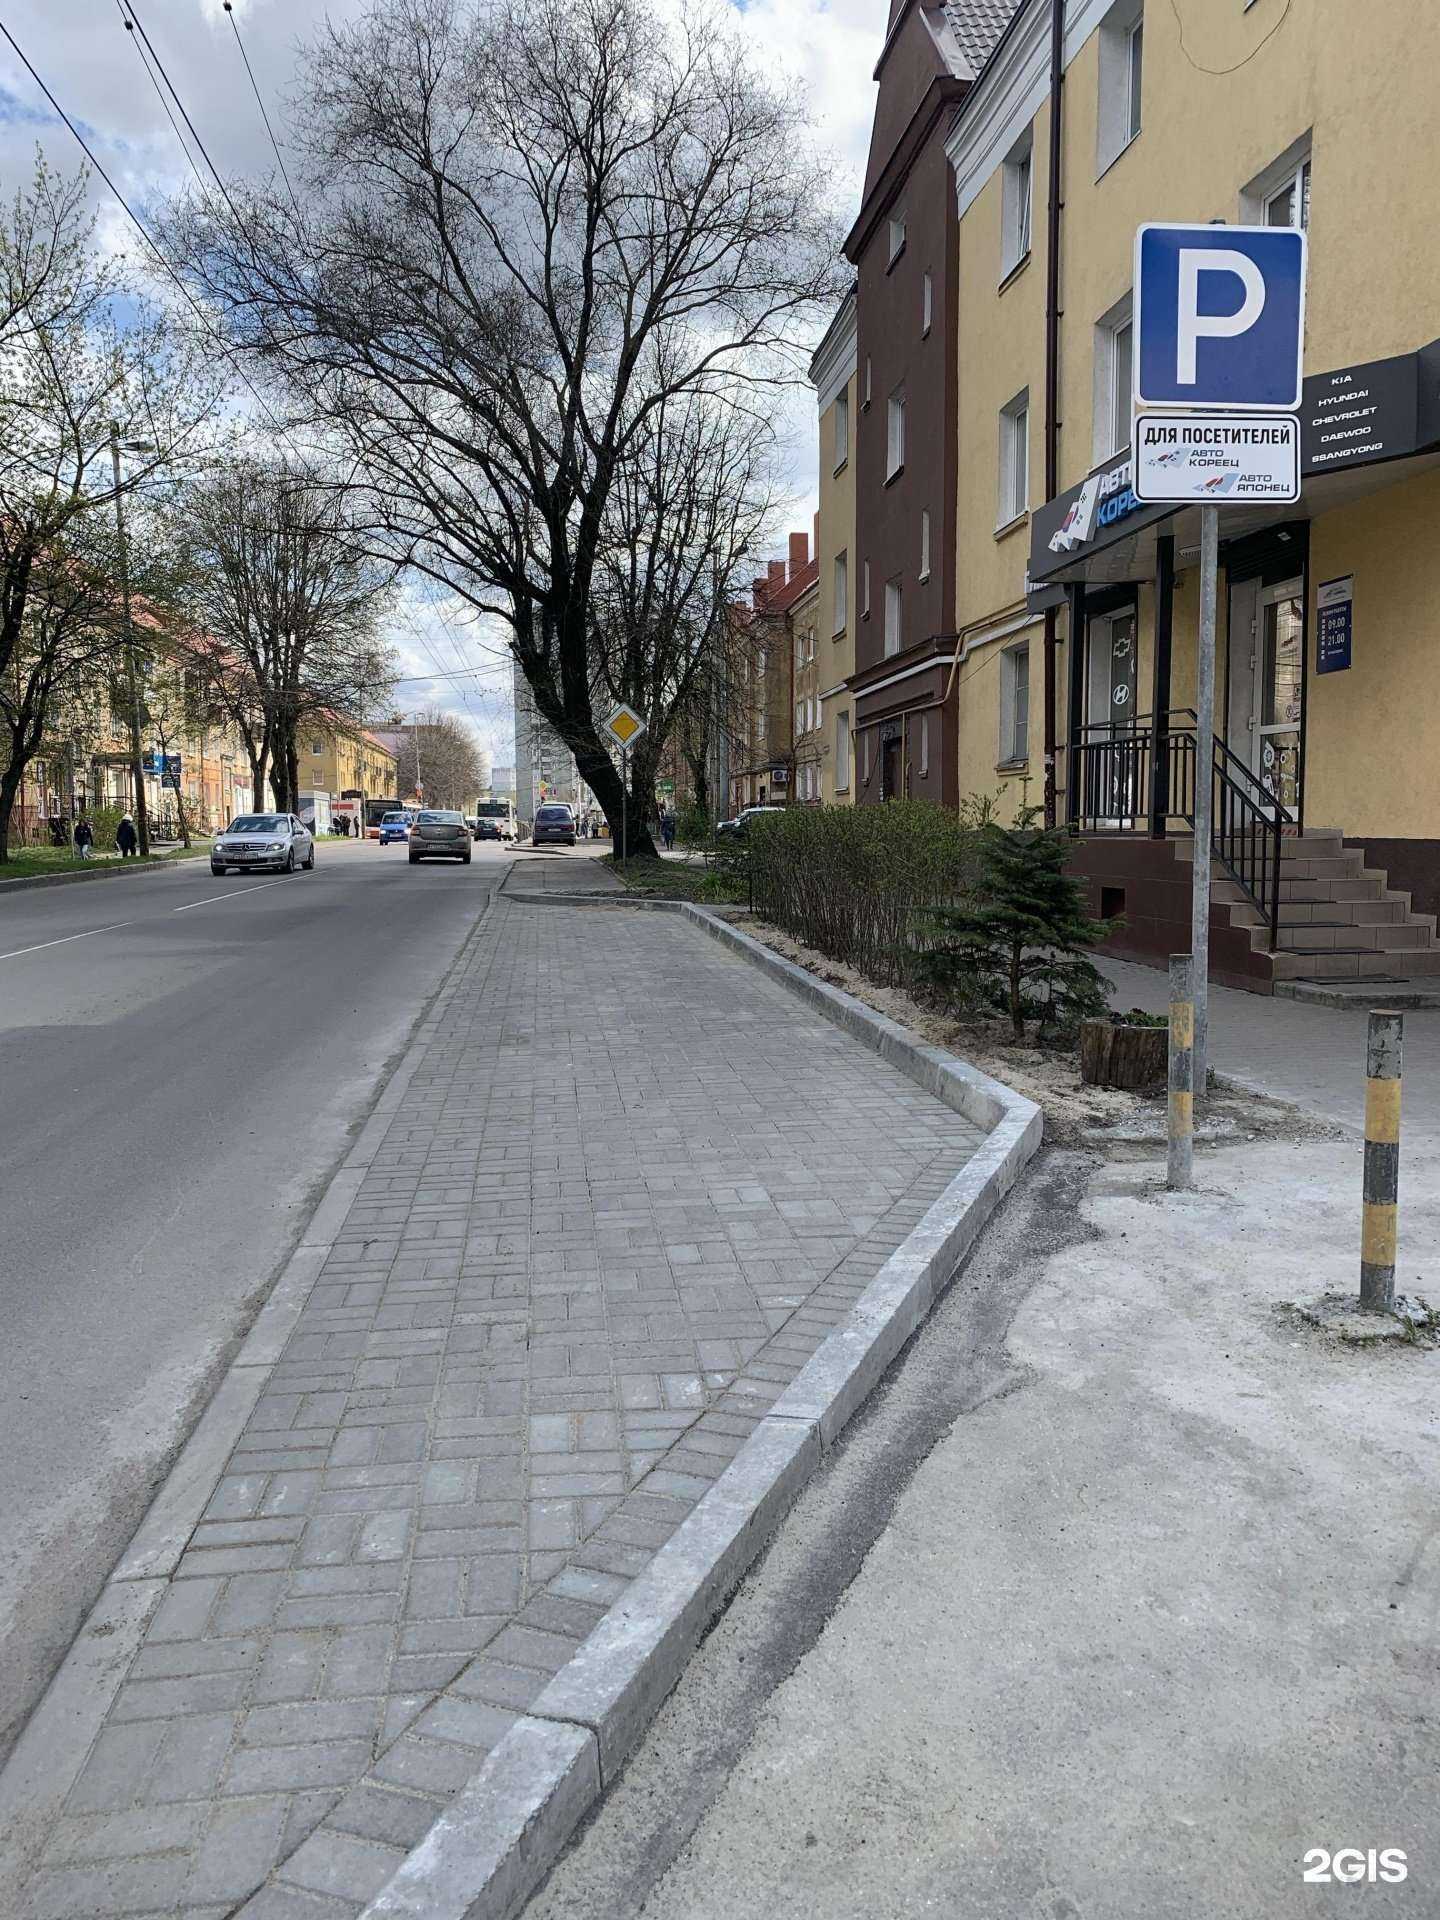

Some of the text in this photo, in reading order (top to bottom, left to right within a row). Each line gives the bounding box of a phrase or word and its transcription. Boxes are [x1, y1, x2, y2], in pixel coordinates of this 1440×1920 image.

[1176, 248, 1266, 385] P
[1331, 375, 1353, 386] KIA
[1318, 389, 1370, 408] HYUNDAI
[1311, 405, 1379, 427] CHEVROLET
[1144, 424, 1291, 446] ДЛЯ ПОСЕТИТЕЛЕЙ
[1320, 426, 1372, 443] DAEWOO
[1190, 449, 1225, 458] АВТО
[1311, 442, 1384, 464] SSANGYONG
[1188, 458, 1240, 468] КОРЕЕЦ
[1098, 461, 1132, 499] АВТ
[1238, 474, 1273, 483] АВТО
[1236, 484, 1291, 493] ЯПОНЕЦ
